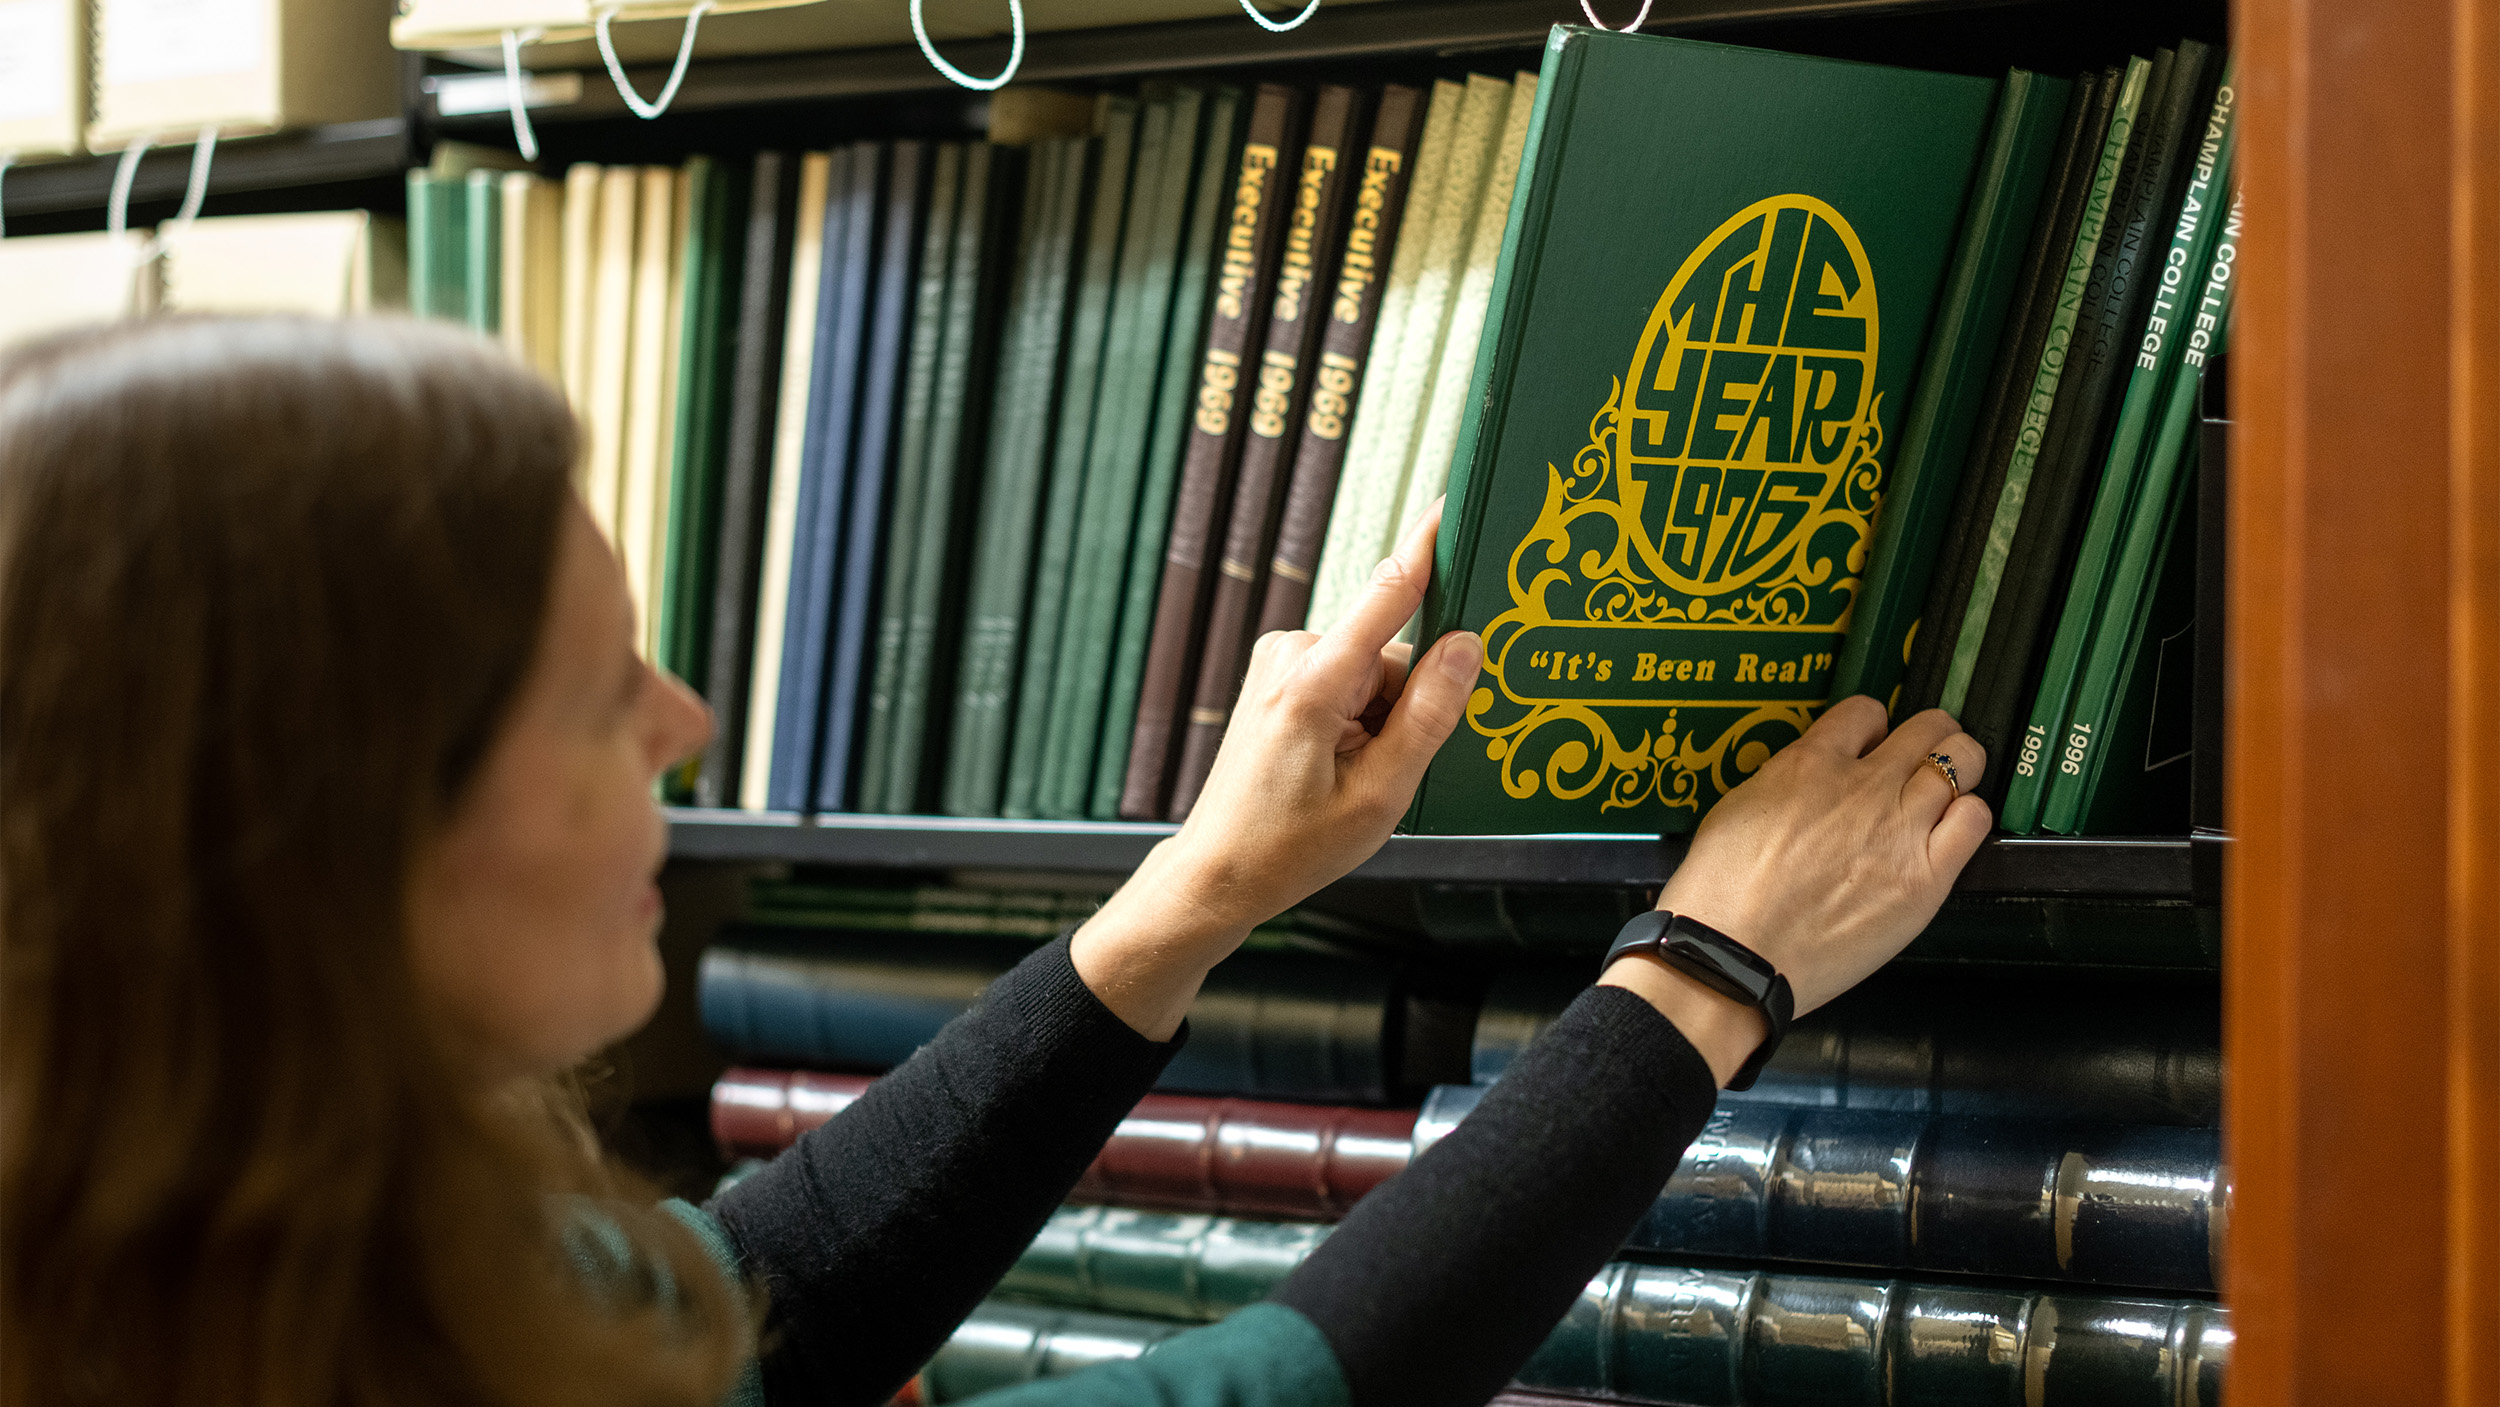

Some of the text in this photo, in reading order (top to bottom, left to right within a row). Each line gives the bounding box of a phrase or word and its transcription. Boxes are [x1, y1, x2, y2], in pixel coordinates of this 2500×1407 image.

[2099, 111, 2151, 258] CHAMPLAIN
[2175, 86, 2234, 242] CHAMPLAIN
[1196, 144, 1278, 436] Executive 1969
[1251, 145, 1337, 438] Executive 1969
[1308, 146, 1402, 440] Executive 1969
[1668, 207, 1867, 353] THE
[2015, 117, 2133, 469] CHAMPLAIN COLLEGE
[2087, 105, 2174, 373] CHAMPLAIN COLLEGE
[2137, 247, 2187, 372] COLLEGE
[2184, 243, 2237, 369] COLLEGE
[1630, 320, 1866, 466] YEAR
[1630, 462, 1828, 584] 1976
[1631, 652, 1717, 682] Been
[2016, 725, 2046, 778] 1996
[2061, 723, 2092, 777] 1996
